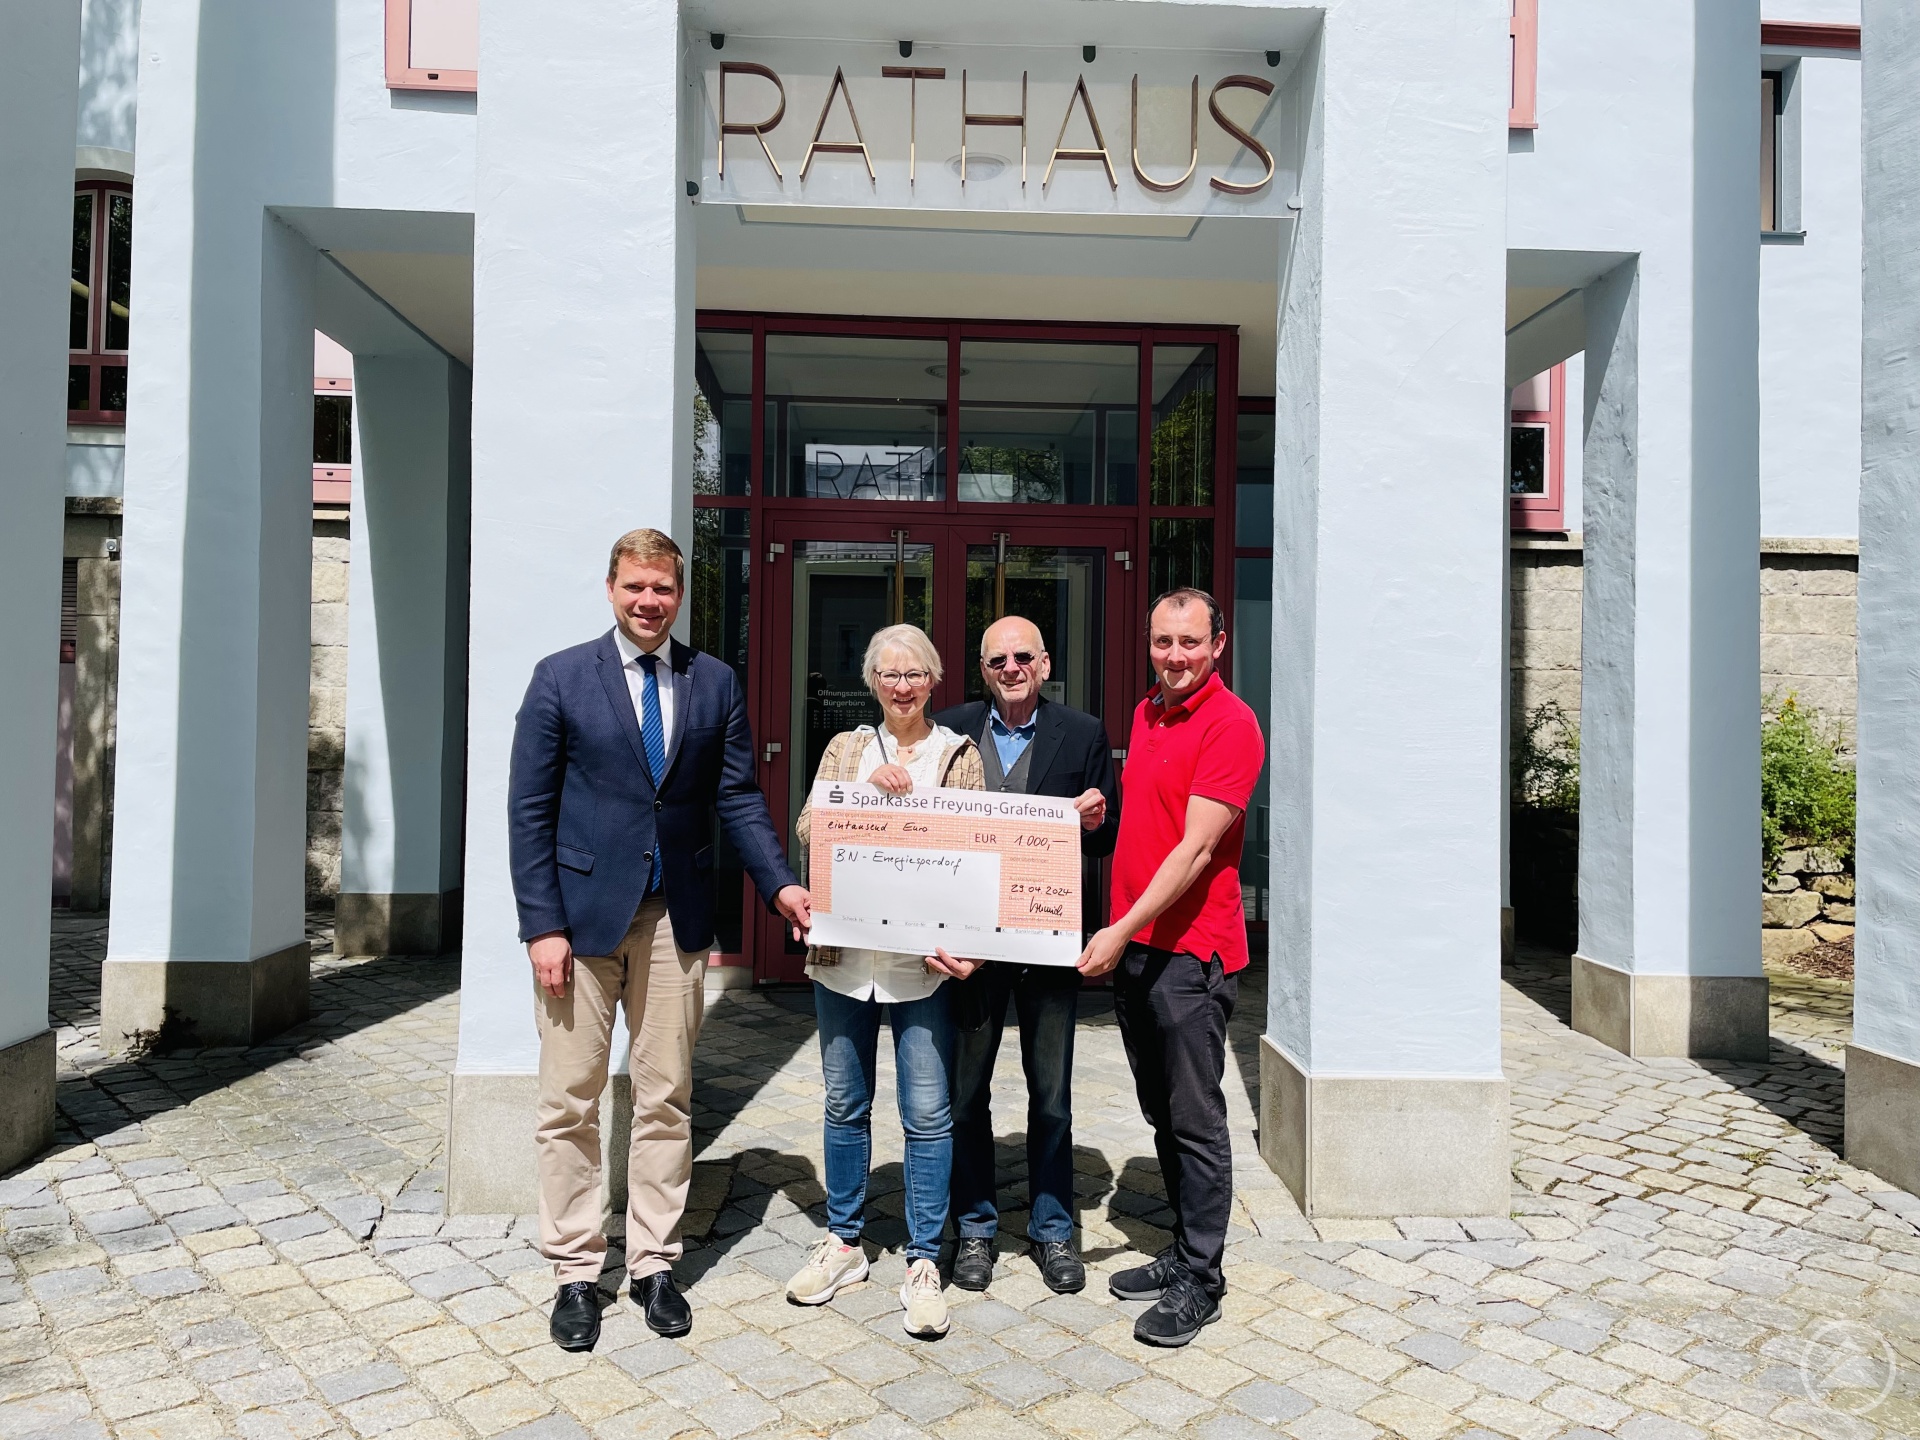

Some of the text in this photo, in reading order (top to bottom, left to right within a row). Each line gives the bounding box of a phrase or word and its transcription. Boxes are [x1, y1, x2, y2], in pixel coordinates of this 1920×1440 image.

[718, 61, 1276, 195] RATHAUS
[823, 699, 866, 708] Bürgerbüro
[851, 791, 929, 809] Sparkasse
[933, 796, 1065, 819] Freyung-Grafenau
[827, 821, 928, 834] eintausend Euro
[974, 833, 997, 845] EUR
